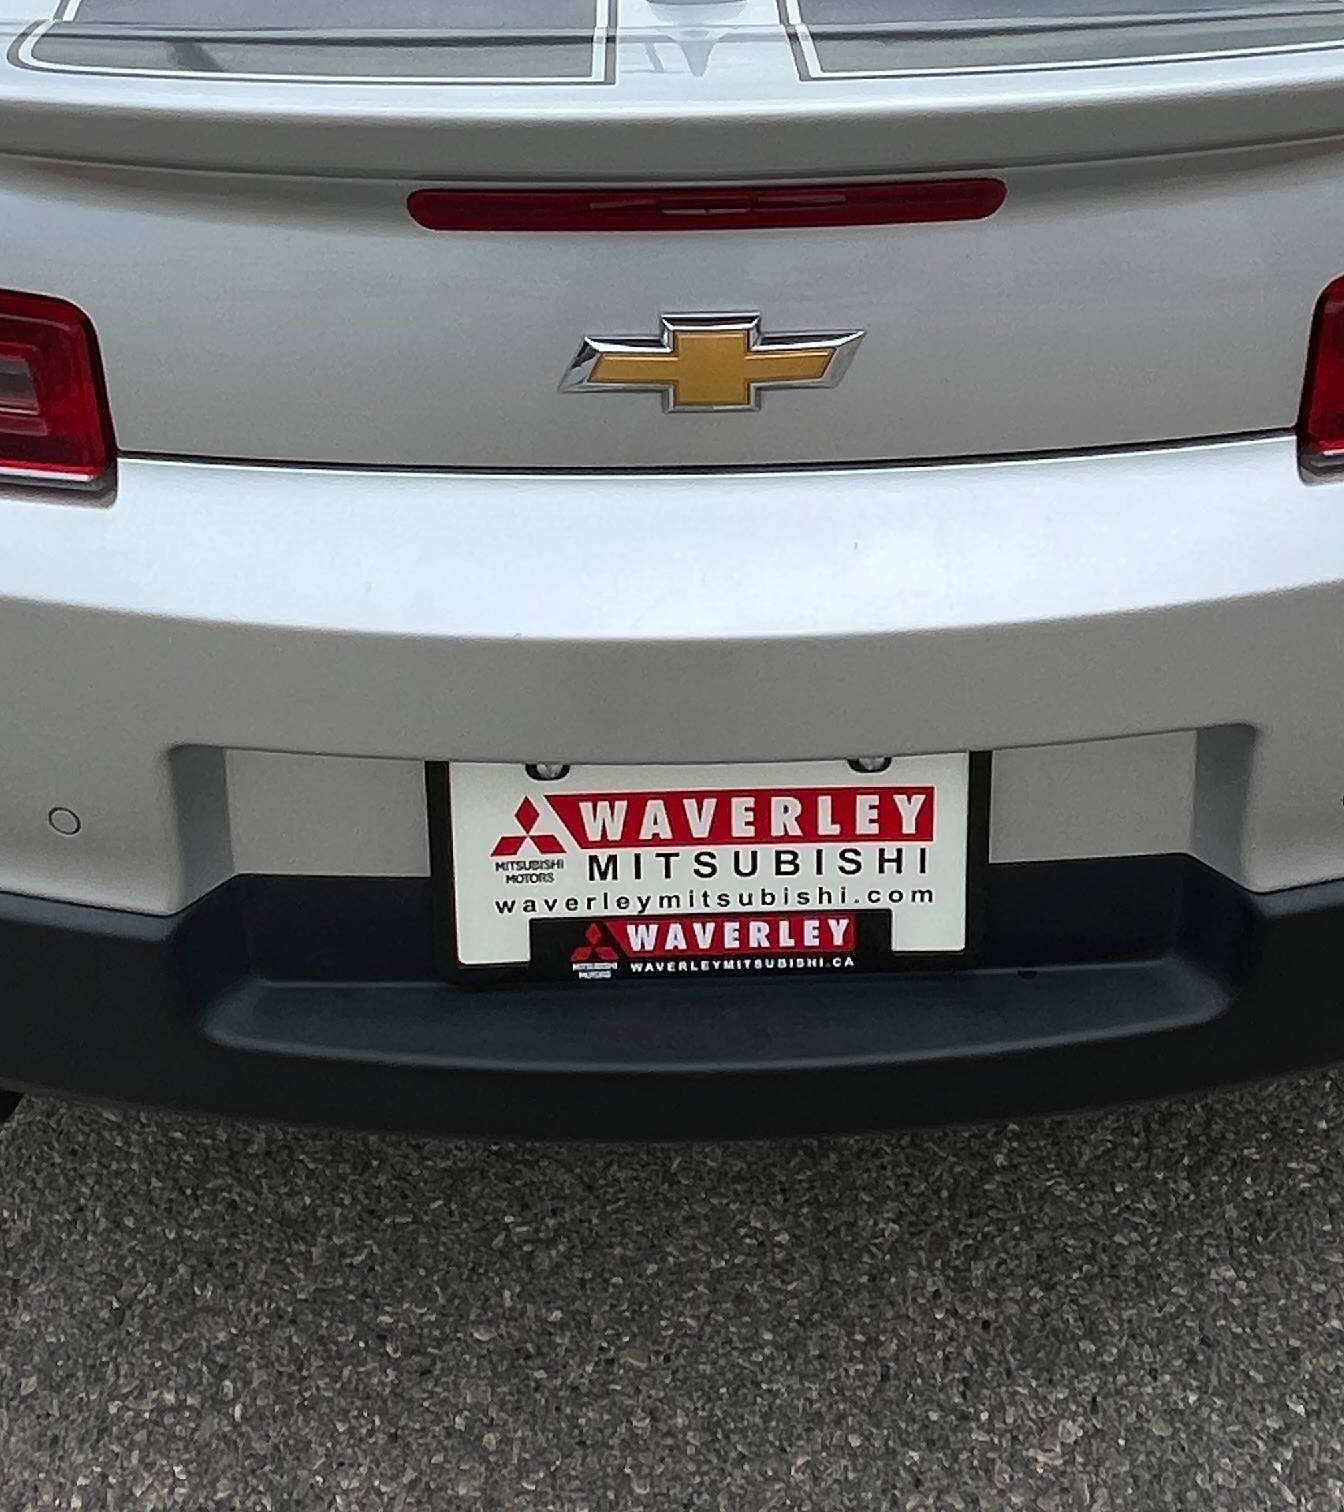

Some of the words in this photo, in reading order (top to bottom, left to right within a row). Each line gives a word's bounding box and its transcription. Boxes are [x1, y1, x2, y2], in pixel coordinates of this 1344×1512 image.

[579, 794, 927, 842] WAVERLEY
[495, 859, 564, 872] MITSUBISHI
[505, 872, 554, 884] MOTORS
[587, 847, 927, 882] MITSUBISHI
[495, 886, 933, 914] waverleymitsubishi.com
[626, 918, 850, 952] WAVERLEY
[630, 956, 855, 973] WAVERLEYMITSUBISHI.CA
